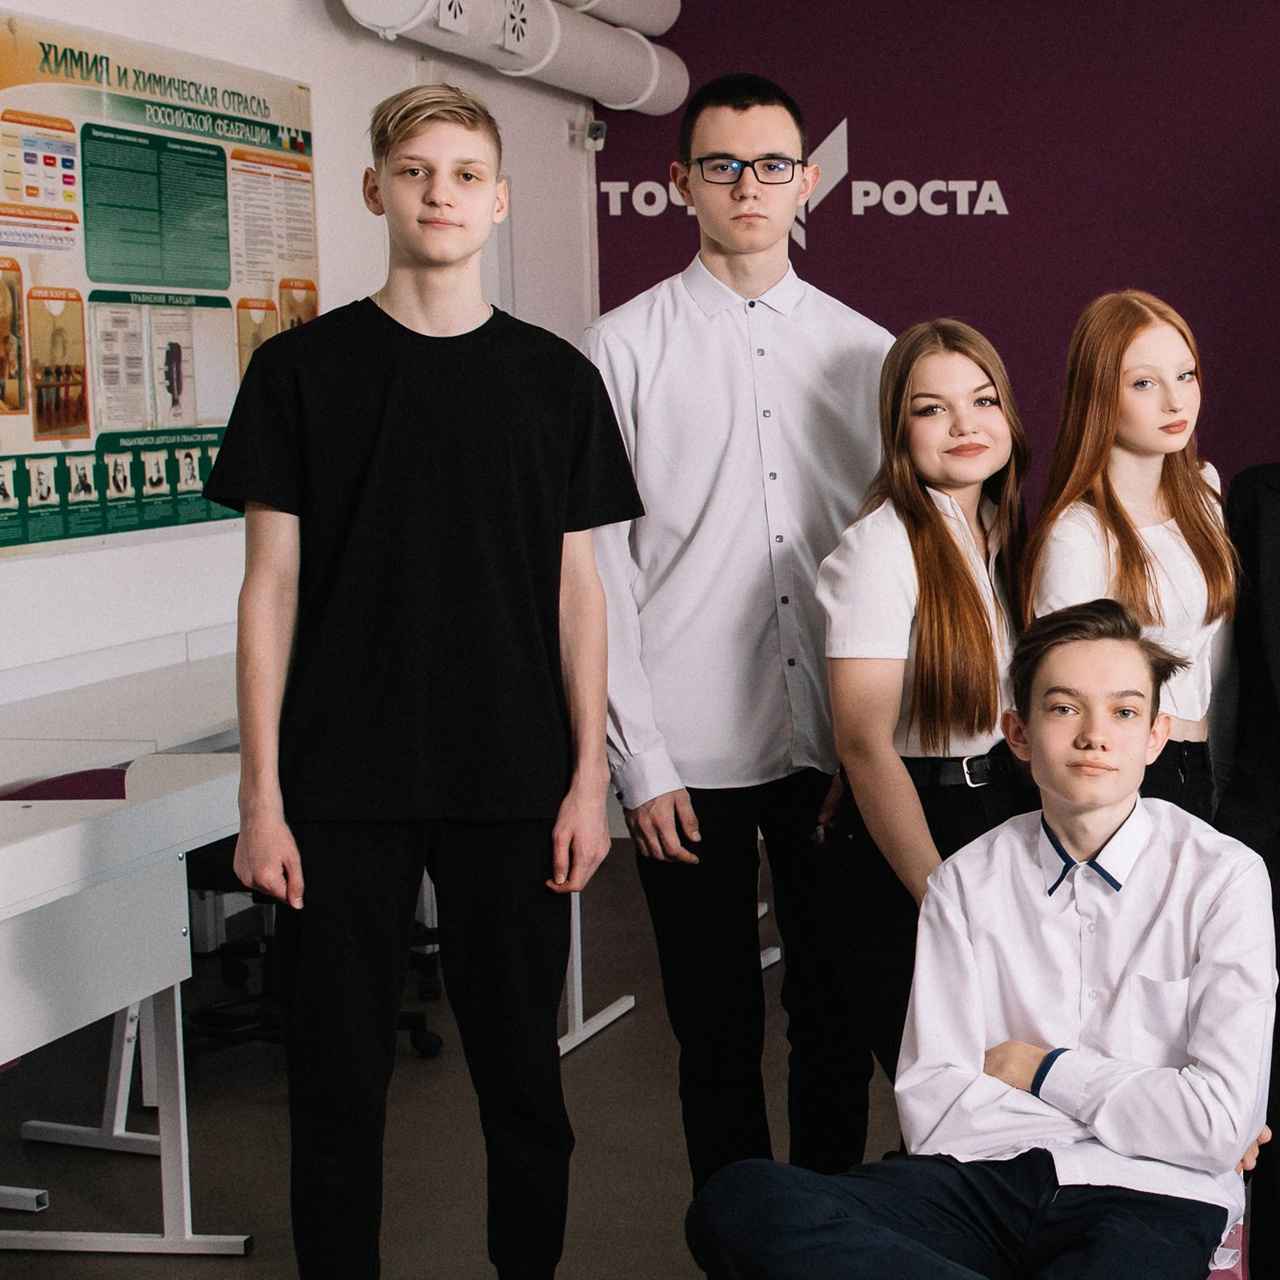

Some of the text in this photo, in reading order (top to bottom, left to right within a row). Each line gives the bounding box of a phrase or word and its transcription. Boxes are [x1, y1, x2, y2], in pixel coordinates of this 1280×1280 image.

[38, 41, 270, 119] ХИМИЯ И ХИМИЧЕСКАЯ ОТРАСЛЬ
[145, 104, 271, 145] РОССИЙСКОЙ ФЕДЕРАЦИИ
[851, 179, 1009, 216] РОСТА
